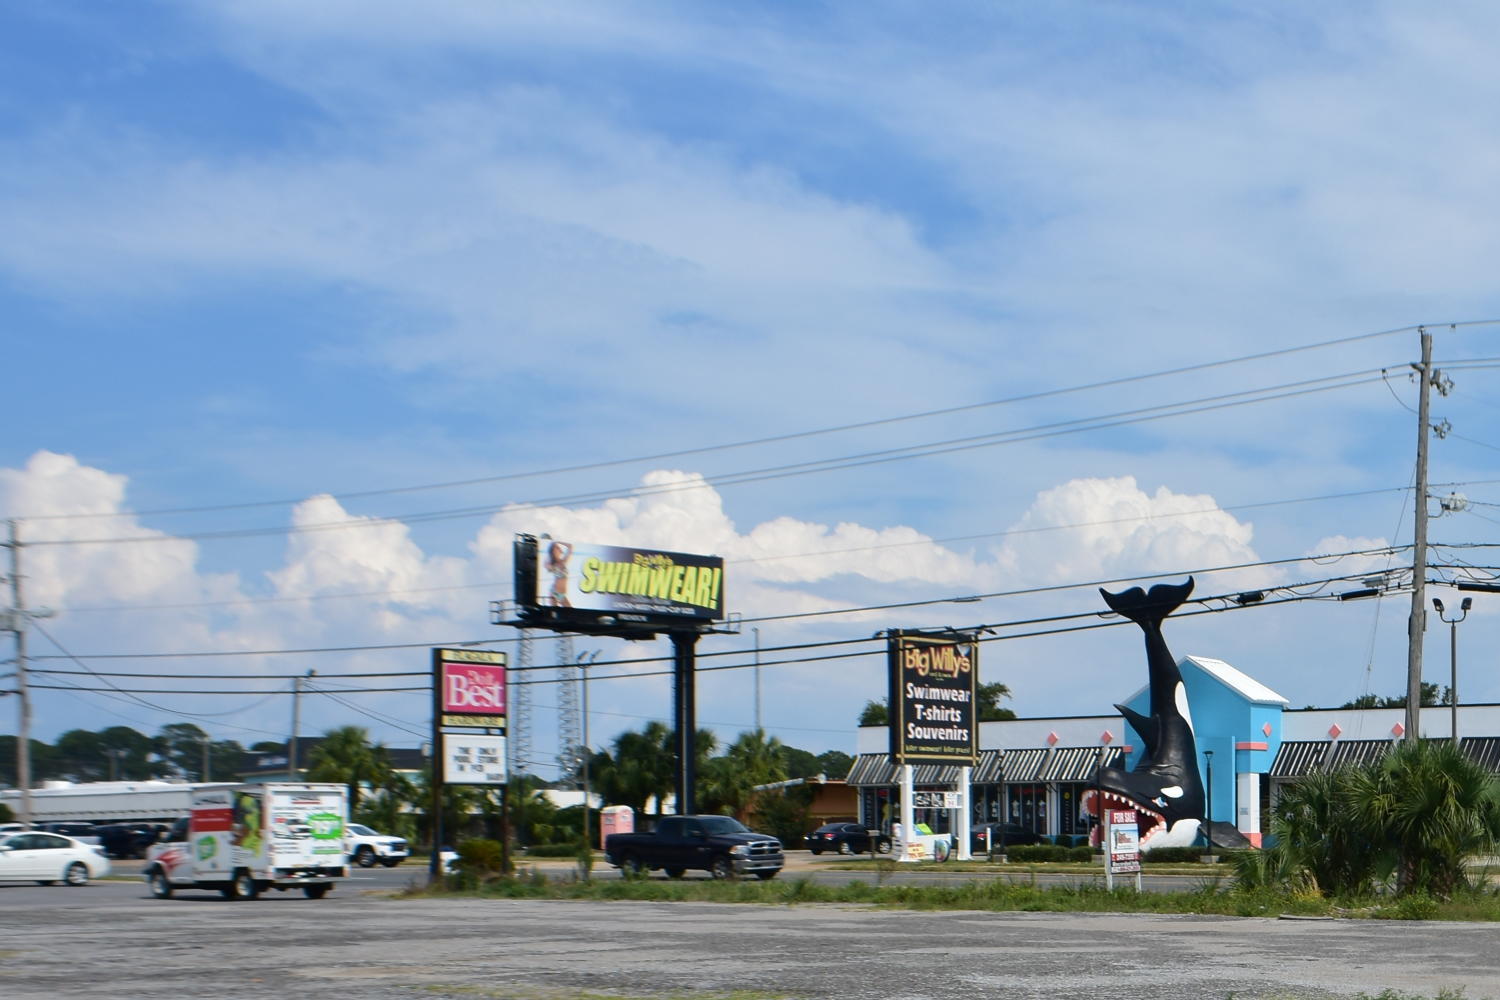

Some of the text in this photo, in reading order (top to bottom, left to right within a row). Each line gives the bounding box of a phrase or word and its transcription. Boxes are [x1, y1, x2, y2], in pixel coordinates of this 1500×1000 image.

[579, 557, 721, 609] SWIMWEAR!
[905, 643, 929, 676] Big
[447, 673, 504, 707] Best
[906, 682, 970, 702] Swimwear
[914, 704, 962, 722] T-shirts
[907, 722, 968, 741] Souvenirs
[1114, 812, 1136, 823] FOR SALE
